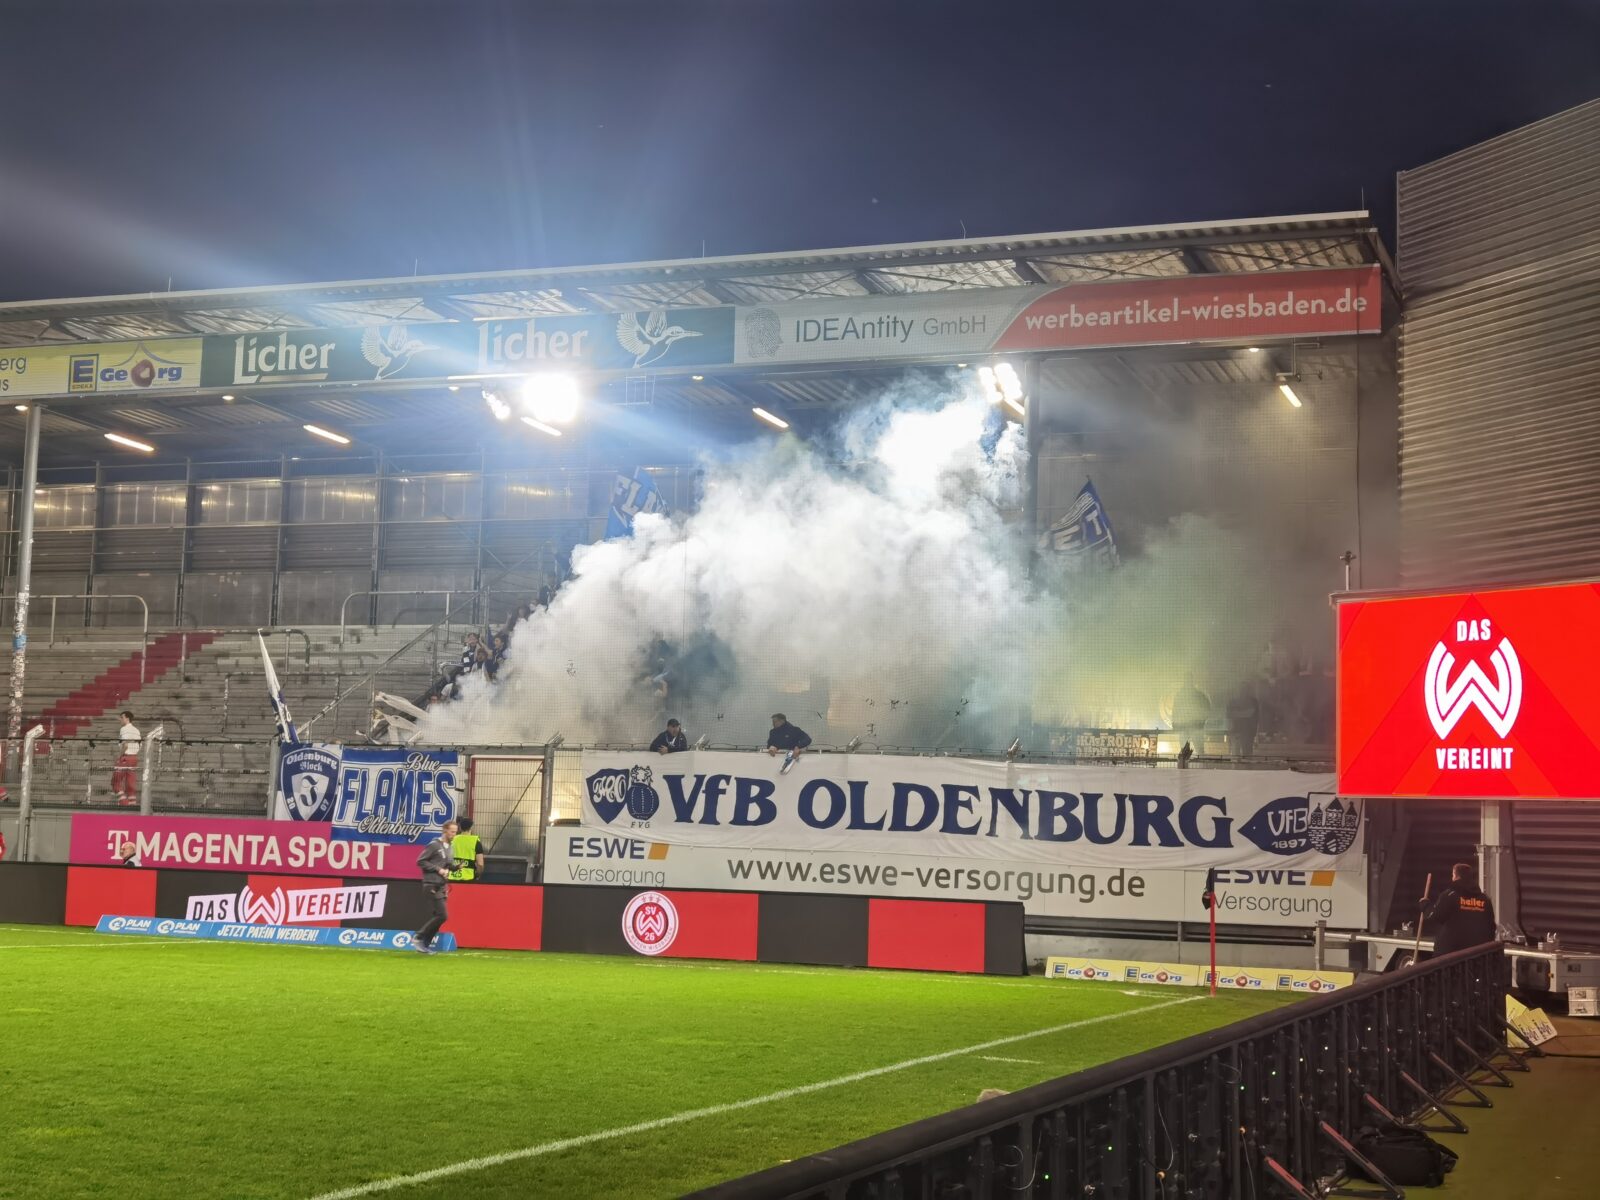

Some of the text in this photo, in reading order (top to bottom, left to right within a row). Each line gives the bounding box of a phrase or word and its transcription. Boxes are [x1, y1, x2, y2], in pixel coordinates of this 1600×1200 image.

[1025, 287, 1367, 330] werbeartikel-wiesbaden.de
[796, 315, 987, 343] IDEAntity GmbH
[476, 318, 589, 370] Licher
[233, 332, 336, 386] Licher
[1457, 619, 1491, 641] DAS
[286, 752, 338, 770] Oldenburg
[405, 751, 441, 771] Blue
[1436, 748, 1513, 769] VEREINT
[334, 767, 456, 827] FLAMES
[662, 774, 1234, 849] VfB OLDENBURG
[1267, 807, 1309, 836] VfB
[358, 815, 425, 843] Oldenburg
[135, 831, 282, 866] MAGENTA
[288, 837, 391, 871] SPORT
[568, 836, 645, 860] ESWE
[1271, 838, 1307, 849] 1897
[568, 864, 666, 887] Versorgung
[727, 858, 1146, 903] www.eswe-versorgung.de
[192, 899, 229, 921] DAS
[295, 890, 379, 916] VEREINT
[645, 906, 657, 916] SV
[1212, 891, 1333, 918] Versorgung
[126, 919, 152, 928] PLAN
[174, 922, 201, 931] PLAN
[217, 924, 248, 937] JETZT
[276, 928, 319, 942] WERDEN!
[358, 931, 385, 941] PLAN
[644, 932, 655, 942] 26
